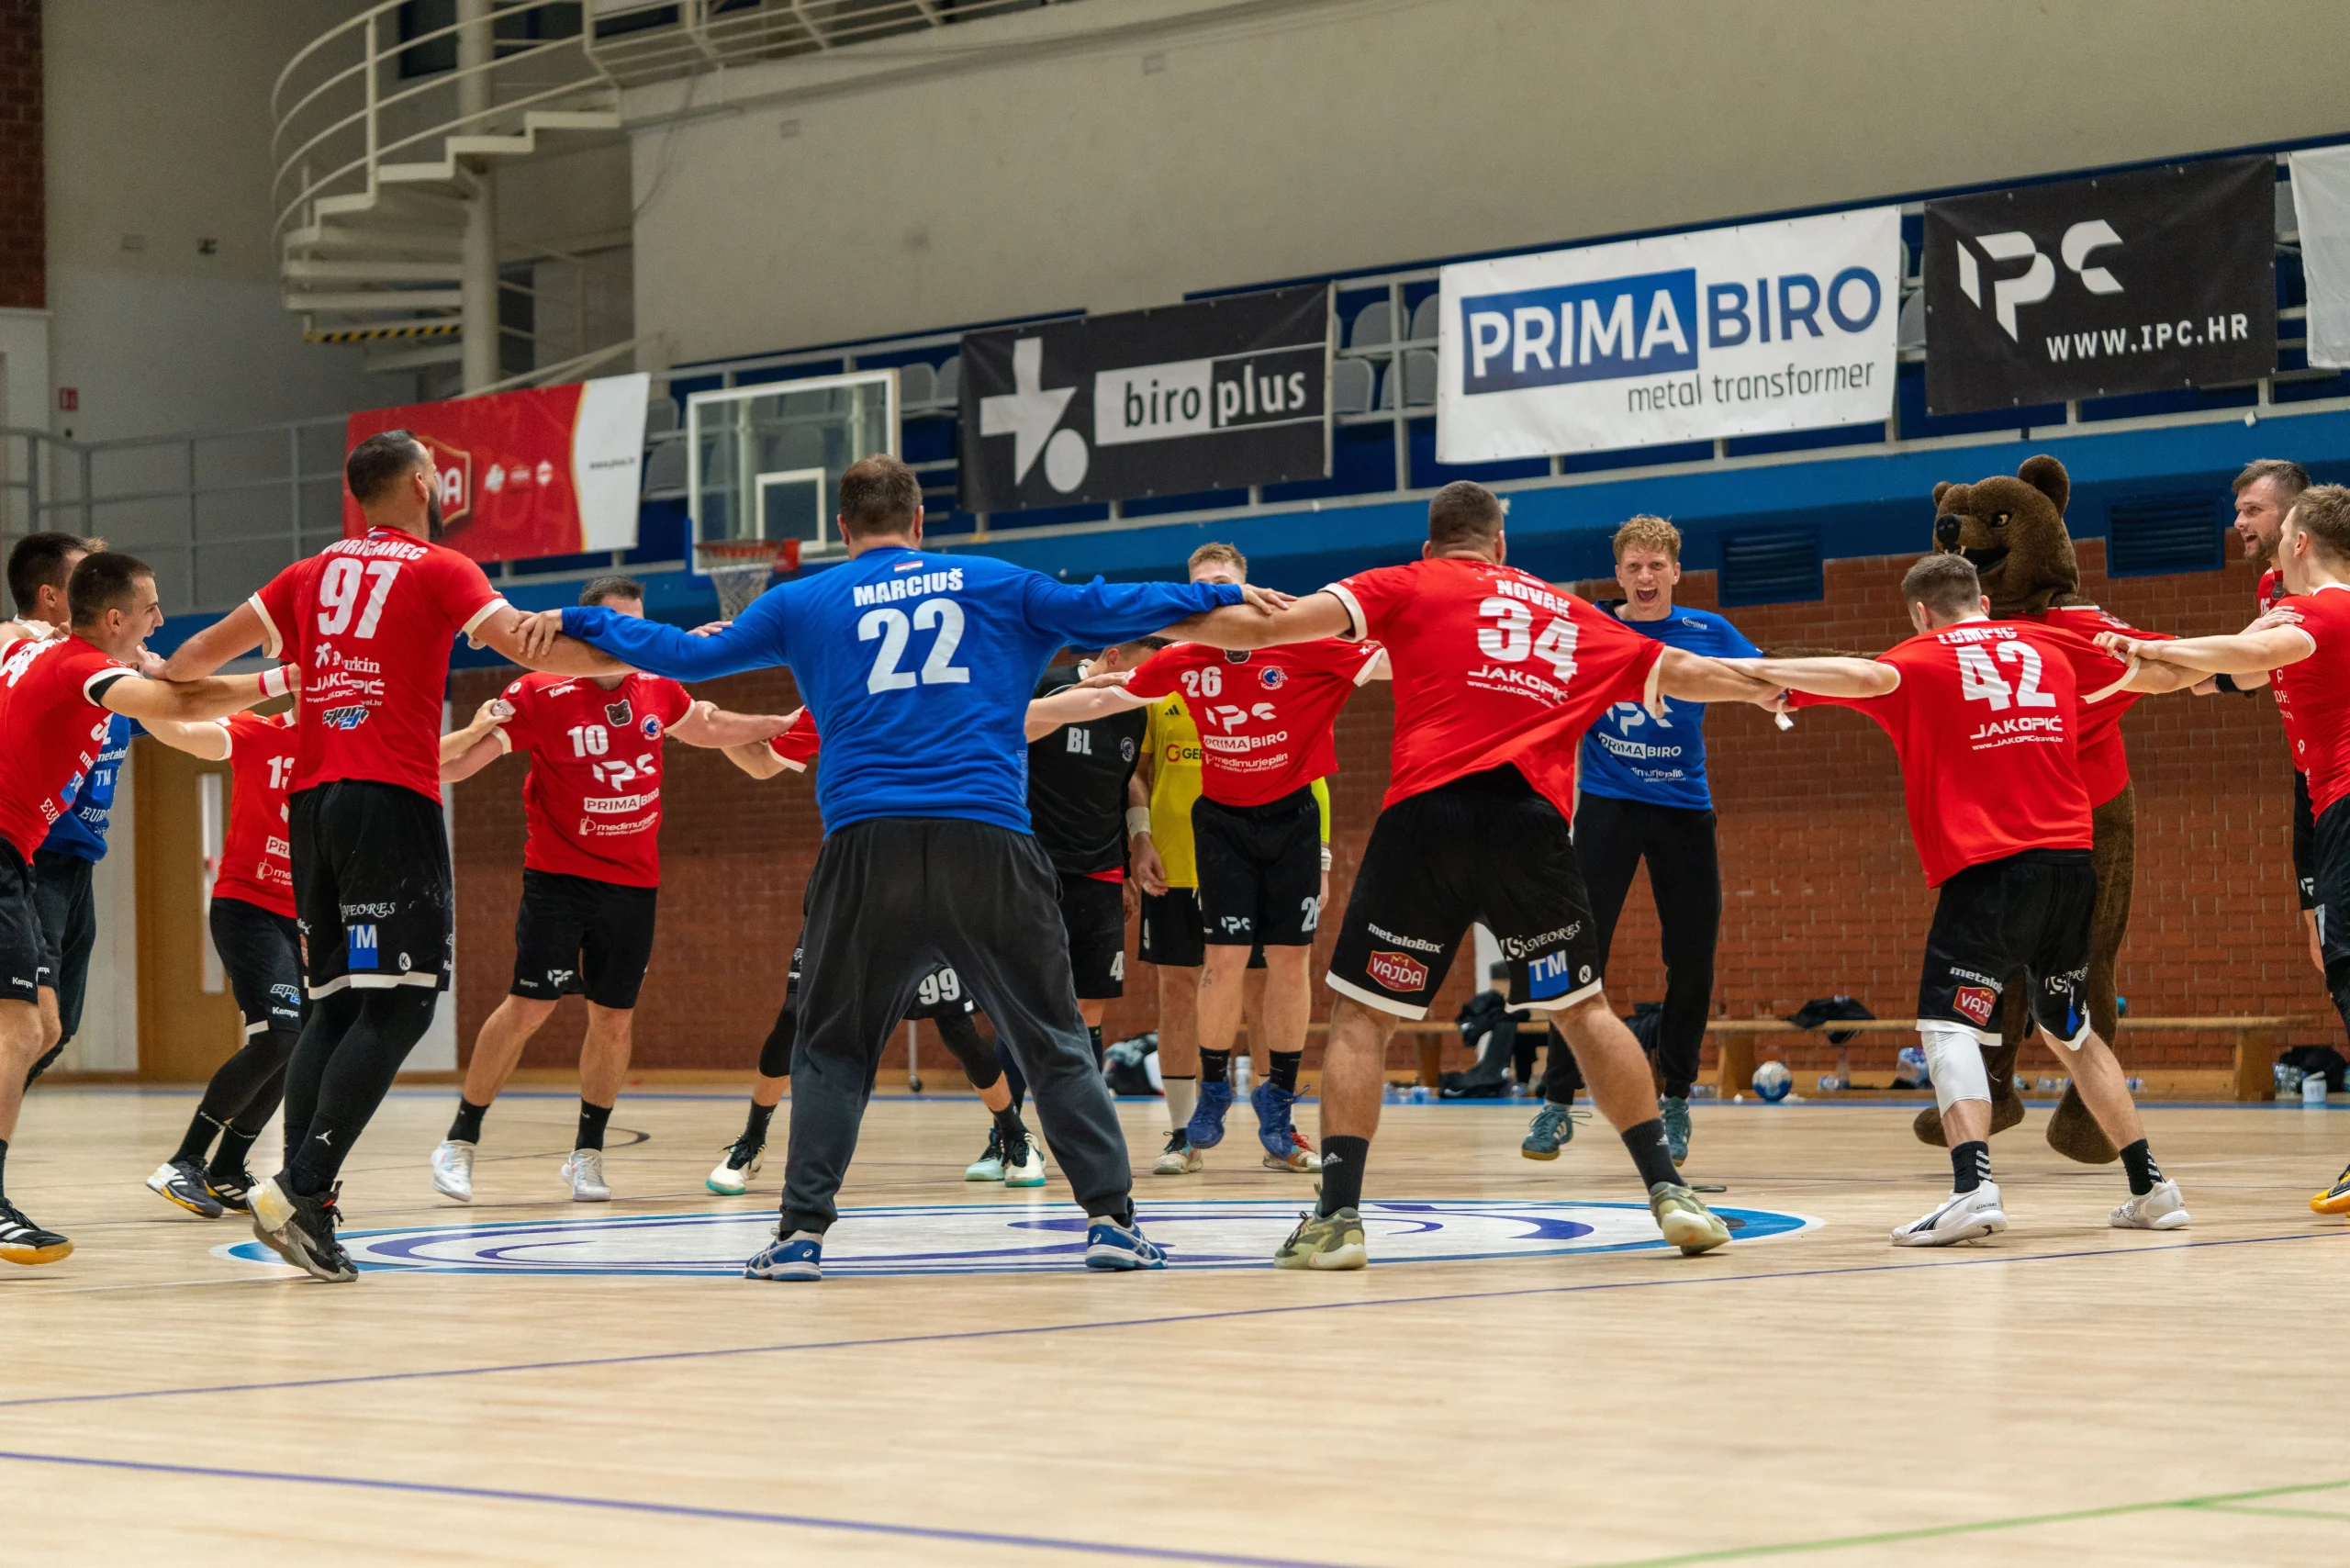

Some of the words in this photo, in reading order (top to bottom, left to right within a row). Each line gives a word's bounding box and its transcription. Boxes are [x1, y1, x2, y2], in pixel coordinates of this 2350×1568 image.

[1470, 289, 1689, 377] PRIMA
[1707, 266, 1881, 349] BIRO
[2046, 313, 2249, 362] WWW.IPC.HR
[1125, 380, 1200, 427] biro
[1218, 364, 1305, 426] plus
[1628, 374, 1702, 413] metal
[1712, 362, 1875, 404] transformer
[318, 557, 403, 639] 97
[853, 568, 963, 607] MARCIUŠ
[1495, 579, 1572, 619] NOVAK
[857, 598, 969, 695] 22
[1477, 596, 1579, 685] 34
[1181, 666, 1222, 698] 26
[1955, 640, 2056, 711] 42
[567, 724, 609, 757] 10
[1066, 726, 1092, 756] BL
[1204, 738, 1248, 749] PRIMA
[1251, 731, 1287, 748] BIRO
[1970, 715, 2064, 740] JAKOPIĆ
[1647, 745, 1682, 757] BIRO
[587, 798, 638, 811] PRIMA
[1368, 923, 1440, 954] metaloBox
[1373, 958, 1422, 986] VAJDA
[1528, 950, 1568, 982] TM
[918, 968, 961, 1005] 99
[272, 1006, 299, 1018] Kempa
[1961, 992, 1993, 1018] VAJD
